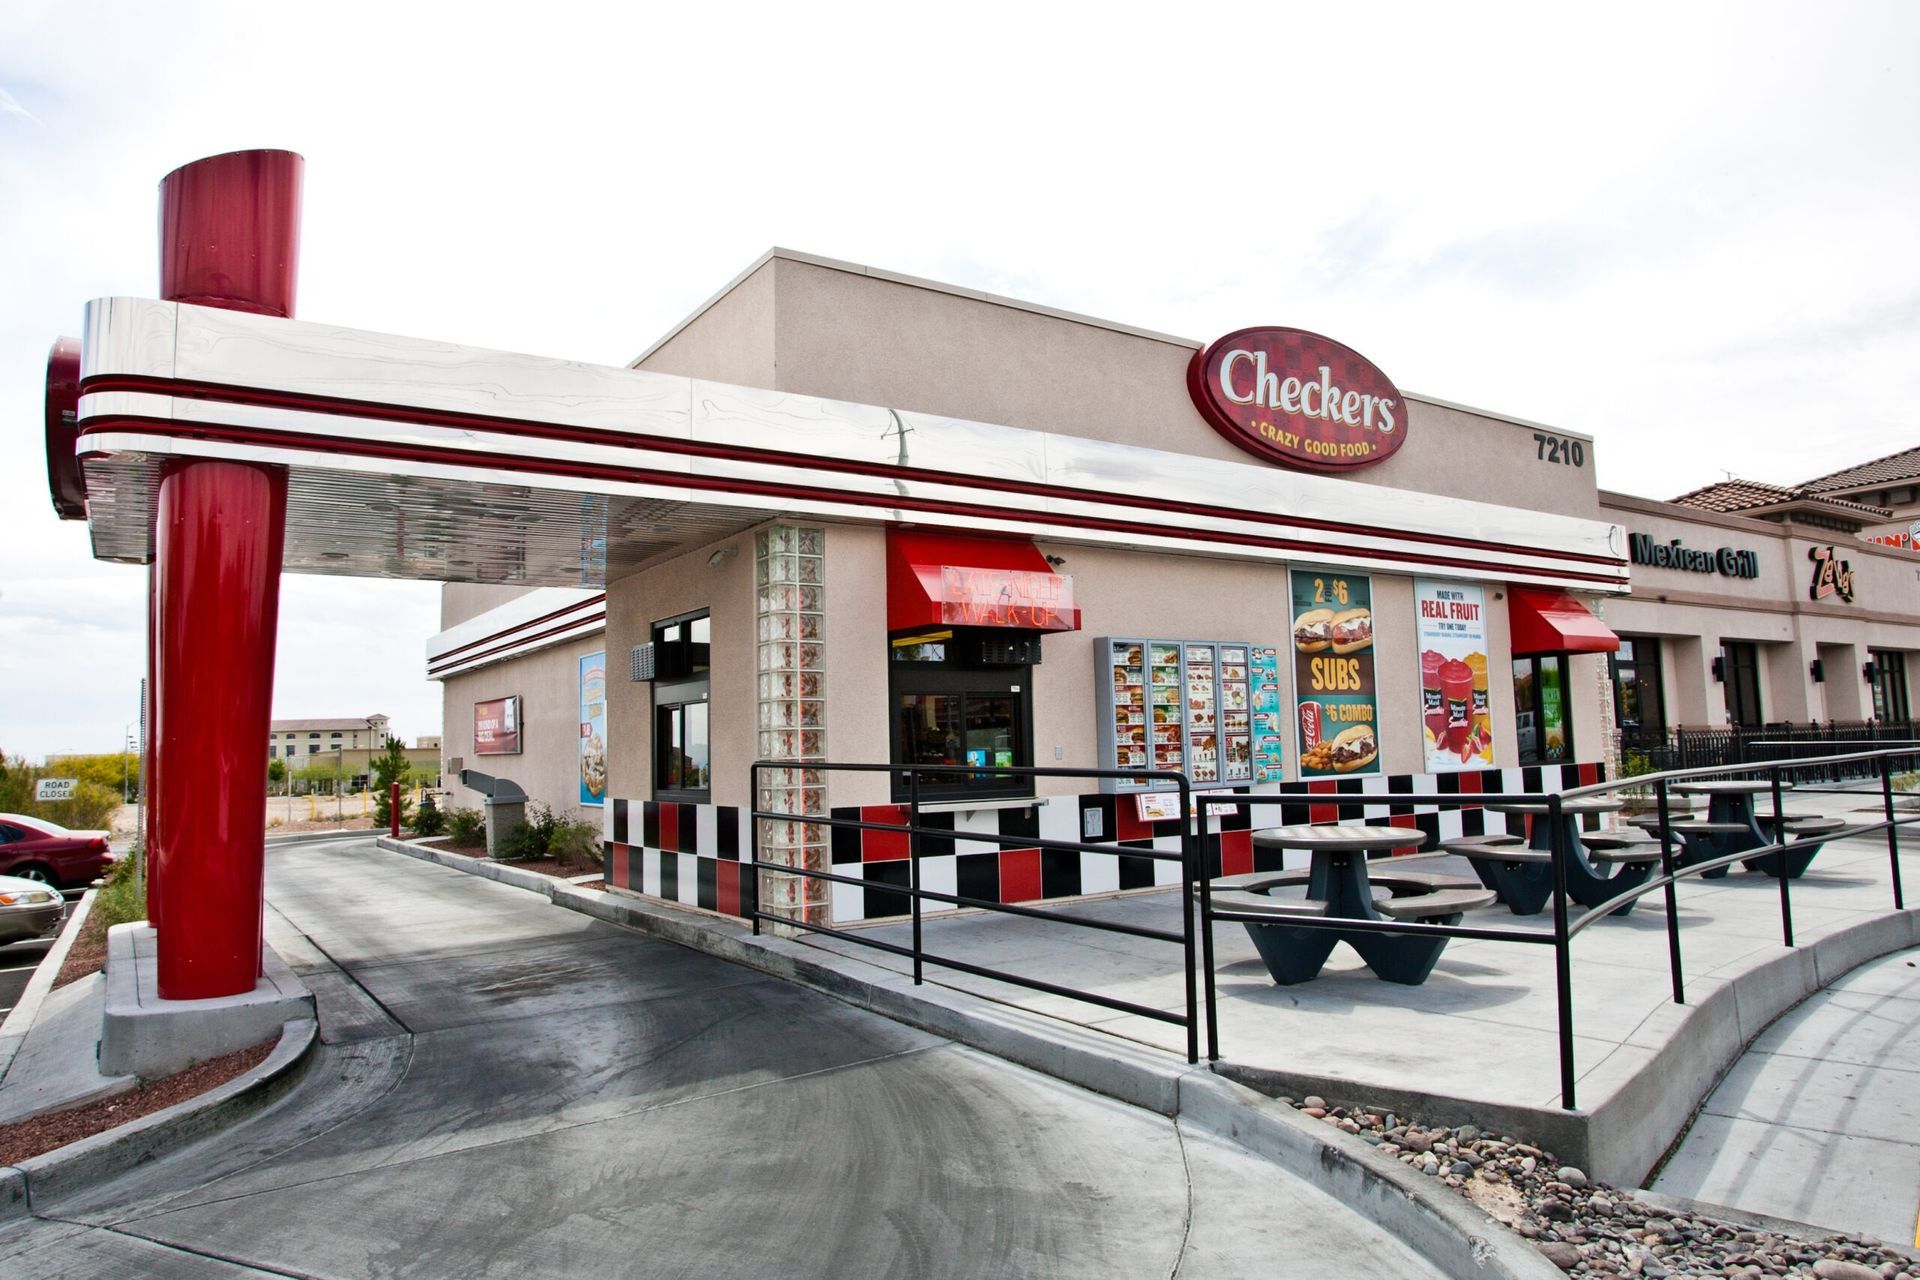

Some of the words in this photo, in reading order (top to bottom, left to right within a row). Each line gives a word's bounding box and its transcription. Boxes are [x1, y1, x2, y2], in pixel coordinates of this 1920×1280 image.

[1220, 349, 1396, 433] Checkers
[1259, 421, 1301, 449] CRAZY
[1304, 438, 1338, 457] GOOD
[1340, 441, 1370, 457] FOOD
[1534, 433, 1584, 467] 7210
[1628, 532, 1717, 574] Mexican
[1716, 546, 1760, 579] Grill
[1314, 578, 1325, 603] 2
[1332, 579, 1348, 605] $6
[960, 600, 1058, 627] WALK-UP
[1421, 600, 1448, 618] REAL
[1450, 602, 1479, 621] FRUIT
[1311, 657, 1361, 690] SUBS
[1325, 704, 1337, 722] $6
[1339, 704, 1373, 722] COMBO
[45, 781, 70, 789] ROAD
